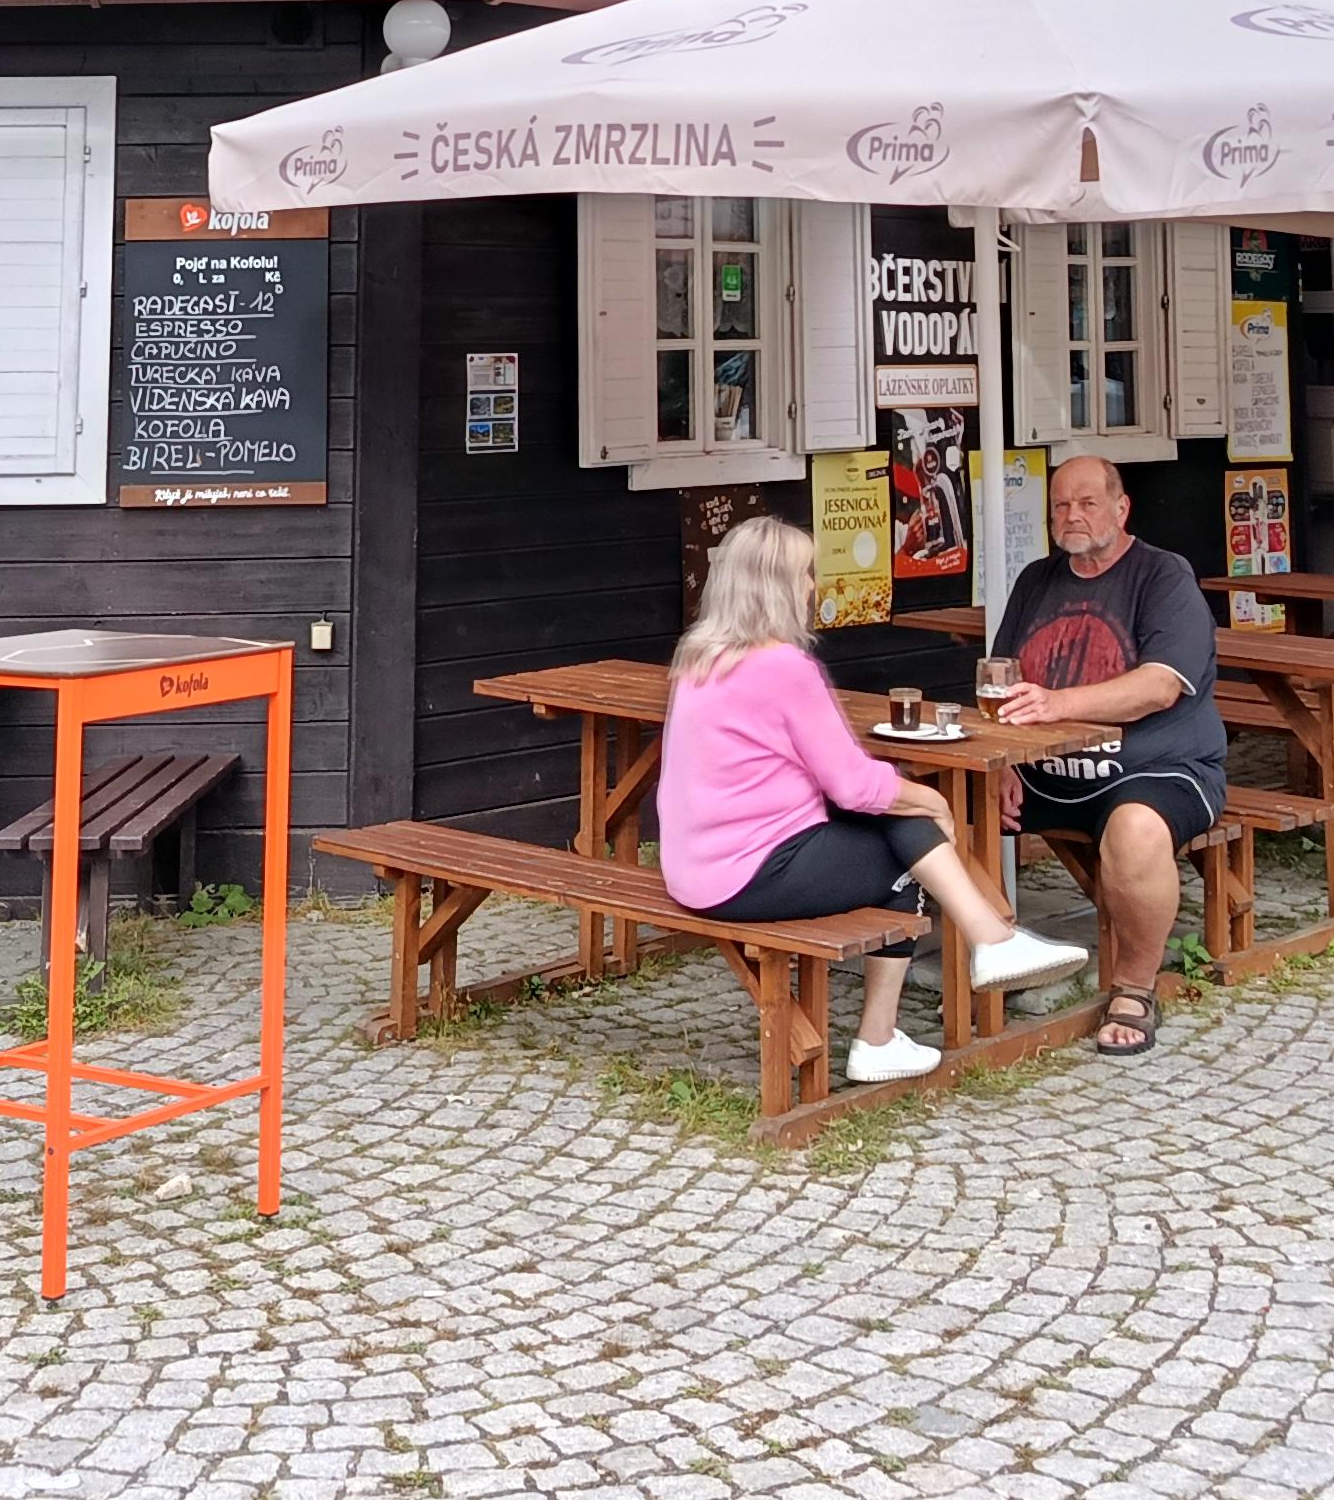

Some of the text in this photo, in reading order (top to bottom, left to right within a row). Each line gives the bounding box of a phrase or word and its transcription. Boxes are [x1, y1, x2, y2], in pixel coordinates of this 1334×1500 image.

[430, 115, 738, 174] ČESKÁ ZMRZLINA
[868, 135, 934, 163] Prima
[1220, 137, 1268, 167] Prima
[293, 154, 338, 177] Prima
[208, 207, 269, 237] kofola
[176, 256, 278, 273] Pojď na Kofolu!
[212, 274, 225, 284] za
[265, 271, 281, 283] Kč
[135, 320, 243, 338] ESPRESSO
[882, 307, 980, 356] VODOPÁ
[127, 364, 281, 385] TURECKÁ KÁVA
[878, 374, 975, 397] LÁZEŇSKÉ OPLATKY
[134, 417, 225, 438] KOFOLA
[1003, 473, 1023, 487] rima
[824, 493, 880, 516] JESENICKÁ
[822, 515, 883, 532] MEDOVINA
[175, 671, 209, 698] kofola
